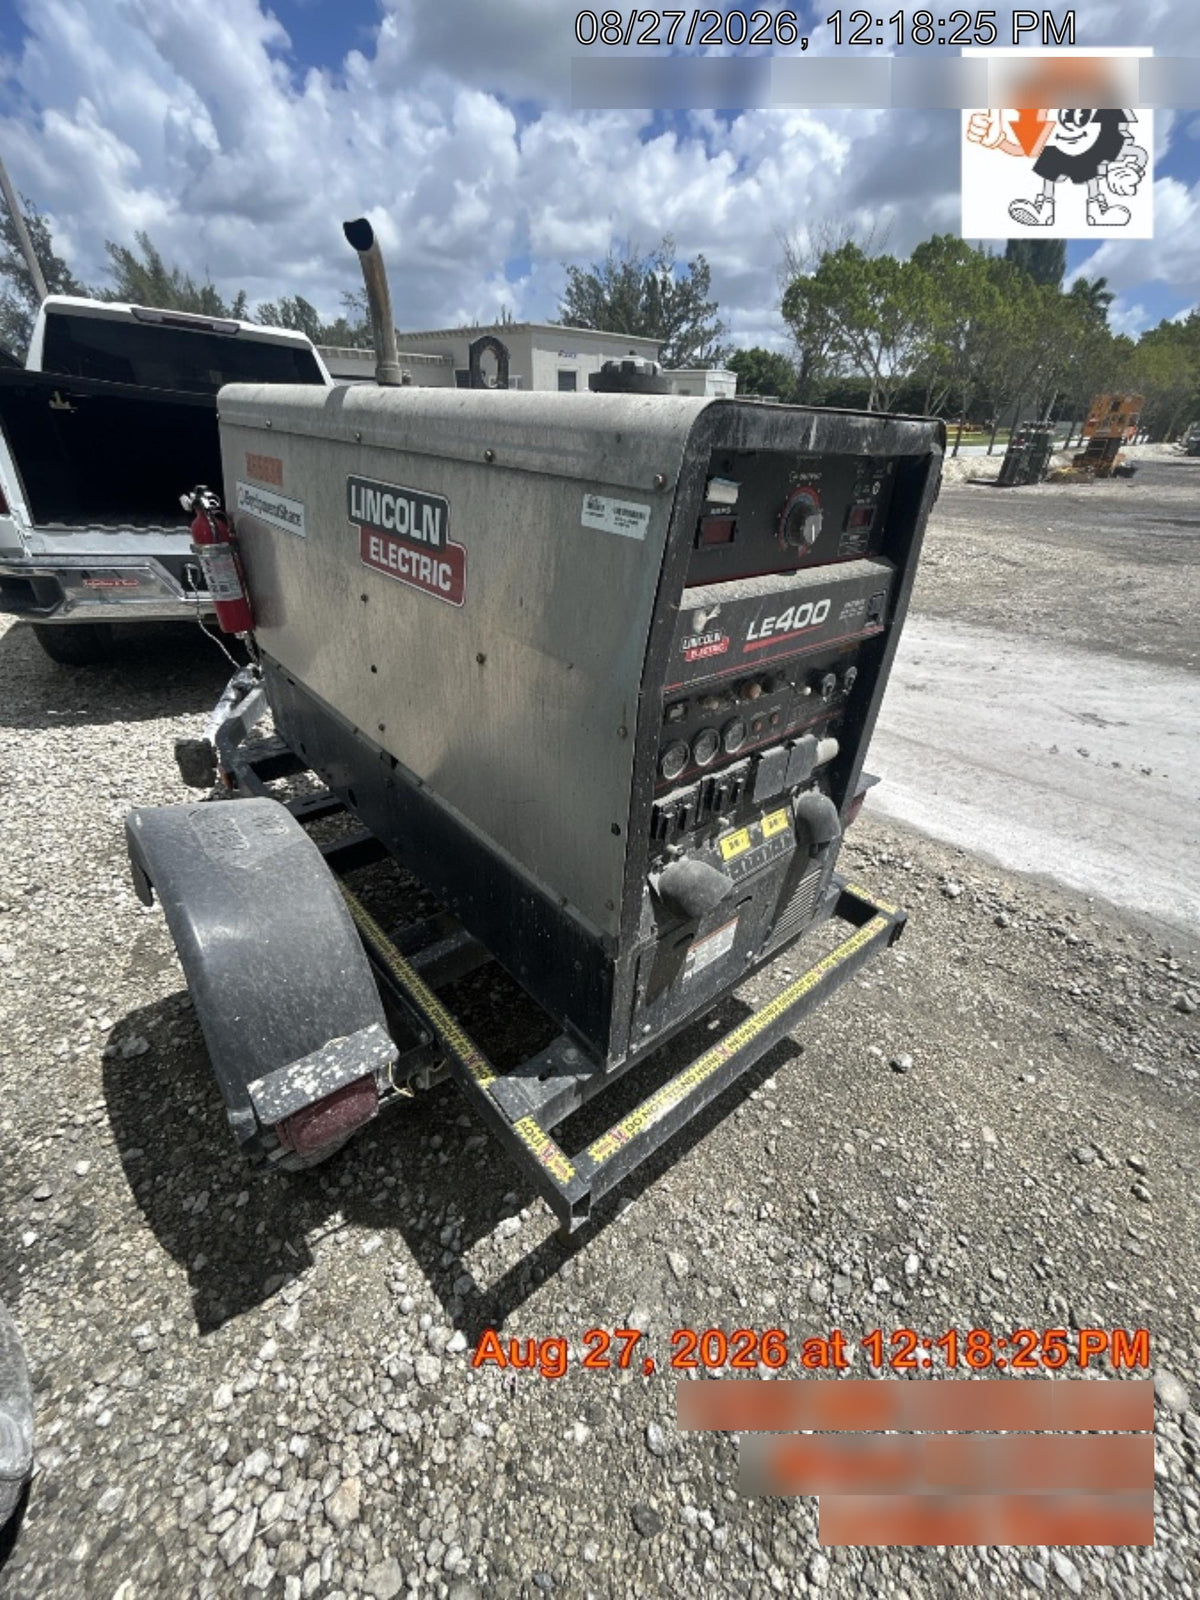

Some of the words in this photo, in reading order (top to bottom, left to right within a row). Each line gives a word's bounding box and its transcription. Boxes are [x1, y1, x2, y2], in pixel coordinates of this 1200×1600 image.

[350, 484, 442, 547] LINCOLN
[368, 536, 453, 591] ELECTRIC
[746, 598, 832, 641] LE400
[624, 1115, 643, 1133] DO
[693, 1051, 721, 1077] HERE
